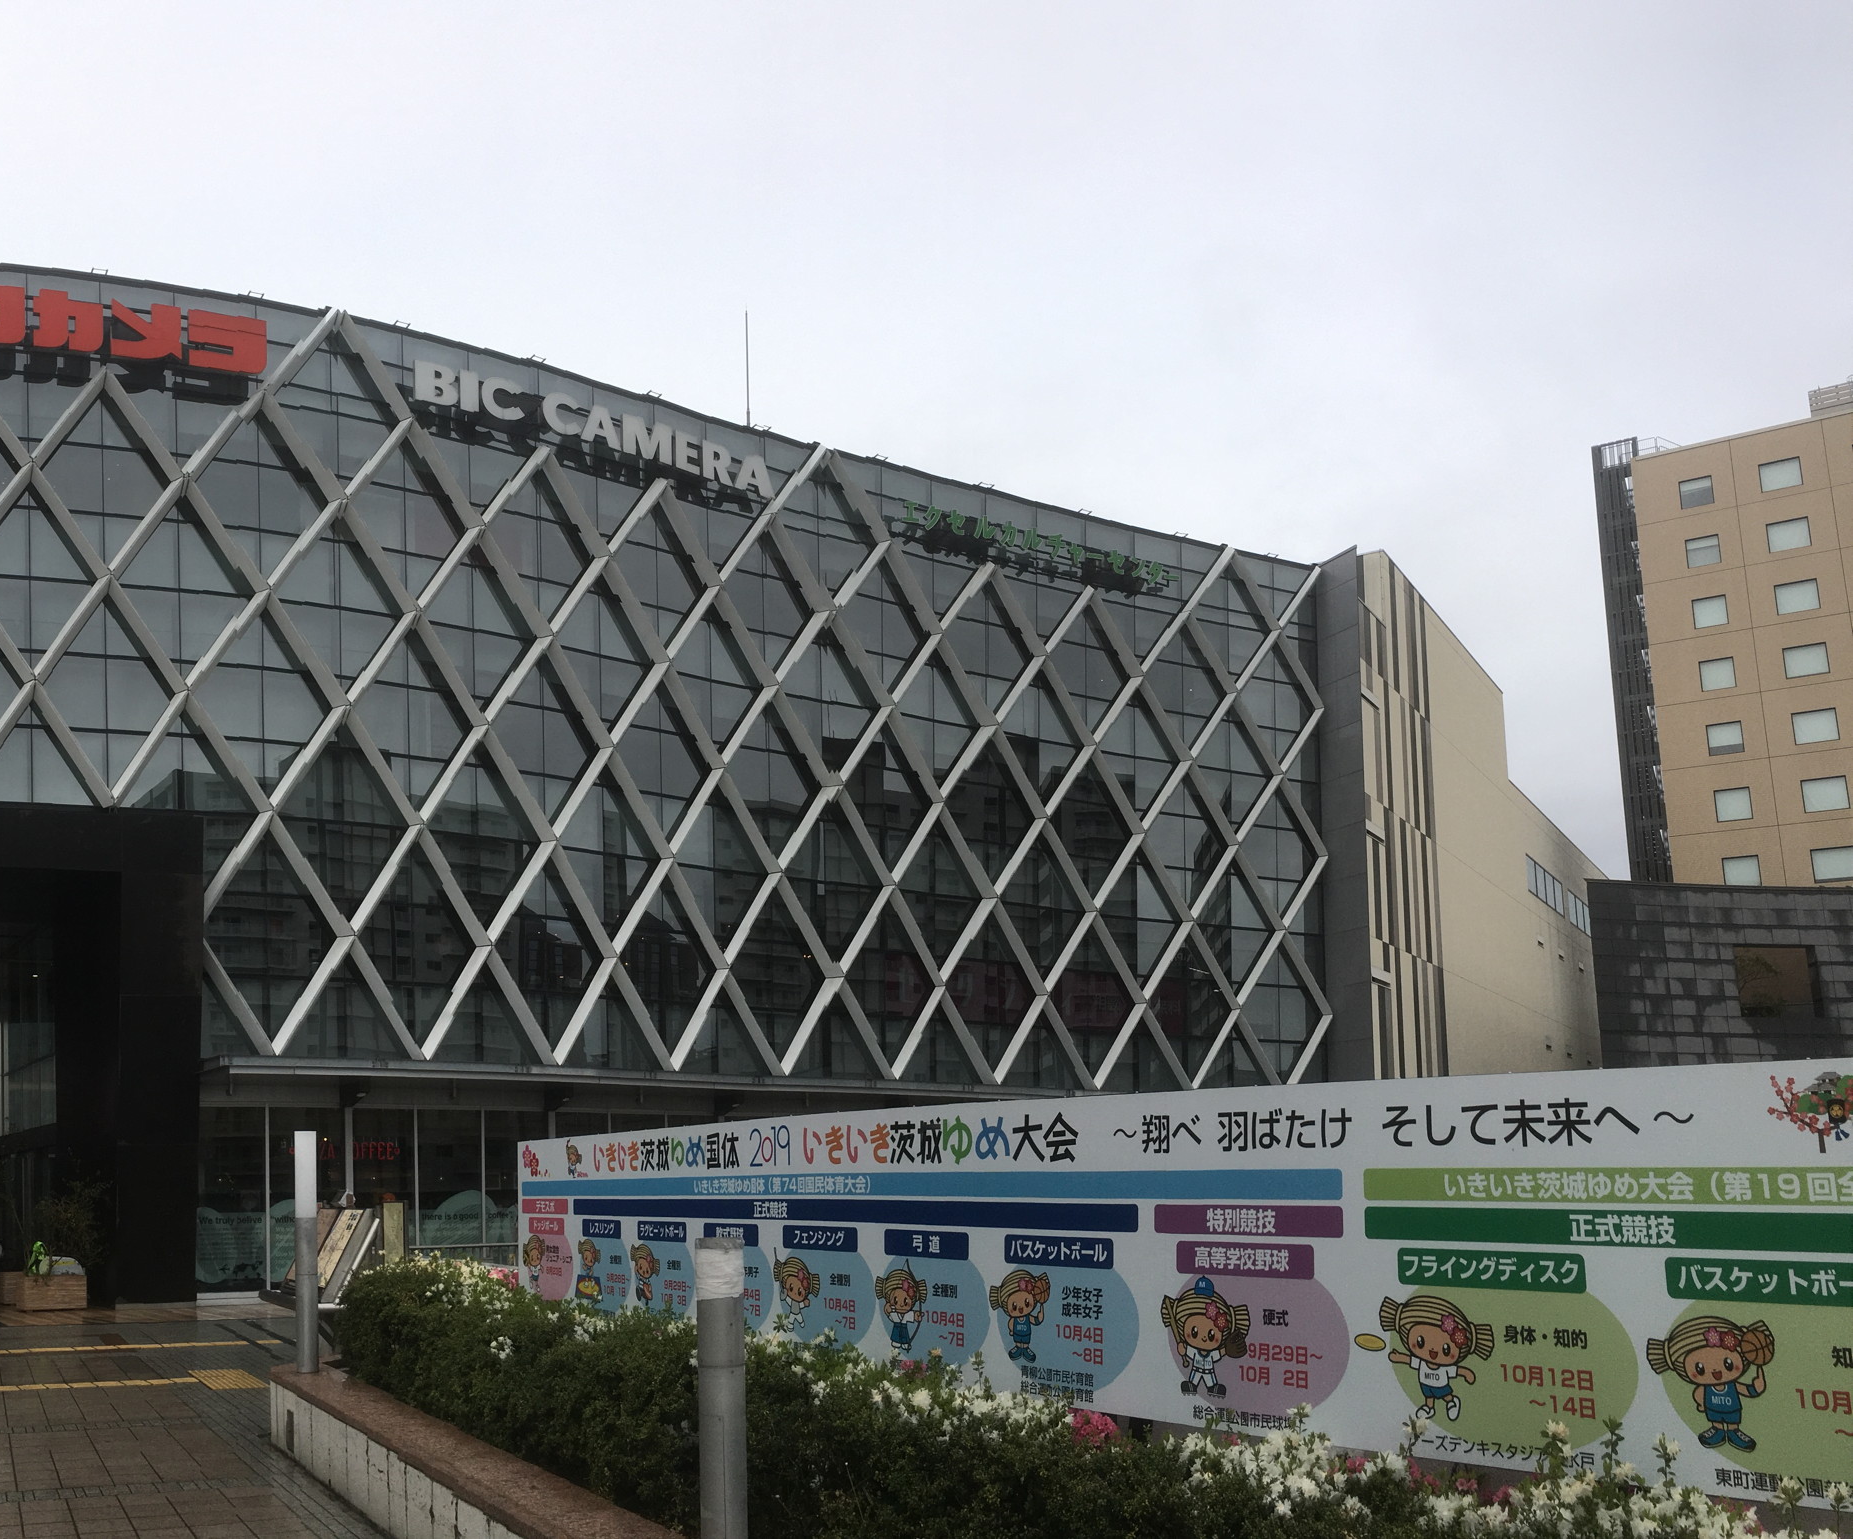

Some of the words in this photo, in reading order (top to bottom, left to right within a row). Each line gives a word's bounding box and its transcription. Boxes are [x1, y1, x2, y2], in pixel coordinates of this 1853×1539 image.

[413, 359, 525, 420] BIC
[543, 392, 776, 500] CAMERA
[901, 501, 1179, 584] エクセルカルチャーセンター
[749, 1125, 791, 1167] 2019
[803, 1112, 1079, 1165] いきいき茨城ゆめ大会
[1217, 1108, 1352, 1152] 羽ばたけ
[1382, 1098, 1640, 1147] そして未来へ
[535, 1201, 555, 1212] デモスポ
[753, 1201, 788, 1218] 正式競技
[199, 1216, 212, 1225] We
[215, 1216, 235, 1226] truly
[422, 1212, 442, 1220] there
[459, 1212, 478, 1221] good
[533, 1220, 558, 1231] ドッジボール
[589, 1222, 615, 1234] レスリング
[1207, 1208, 1276, 1234] 特別競技
[639, 1224, 684, 1238] ラグビーットボール
[793, 1230, 845, 1246] フェンシング
[1569, 1214, 1676, 1245] 正式競技
[912, 1234, 940, 1253] 弓道
[1010, 1239, 1107, 1263] バスケットボール
[1195, 1246, 1289, 1272] 高等学校野球
[1403, 1255, 1580, 1284] フライングディスク
[829, 1273, 851, 1287] 全種別
[932, 1283, 958, 1299] 全種別
[1061, 1285, 1103, 1303] 少年女子
[824, 1297, 856, 1313] 10月4日
[1061, 1302, 1103, 1320] 成年女子
[925, 1310, 965, 1329] 10月4日
[1262, 1308, 1289, 1327] 硬式
[1055, 1324, 1104, 1345] 10月4日
[1504, 1325, 1587, 1349] 身体・知的
[1239, 1365, 1270, 1385] 10月
[1424, 1371, 1440, 1381] MITO
[1500, 1364, 1594, 1392] 10月12日
[1020, 1380, 1094, 1403] 総合運動公園育館
[1711, 1395, 1732, 1405] MITO
[1418, 1434, 1594, 1469] ーズデンキスタジア水戸
